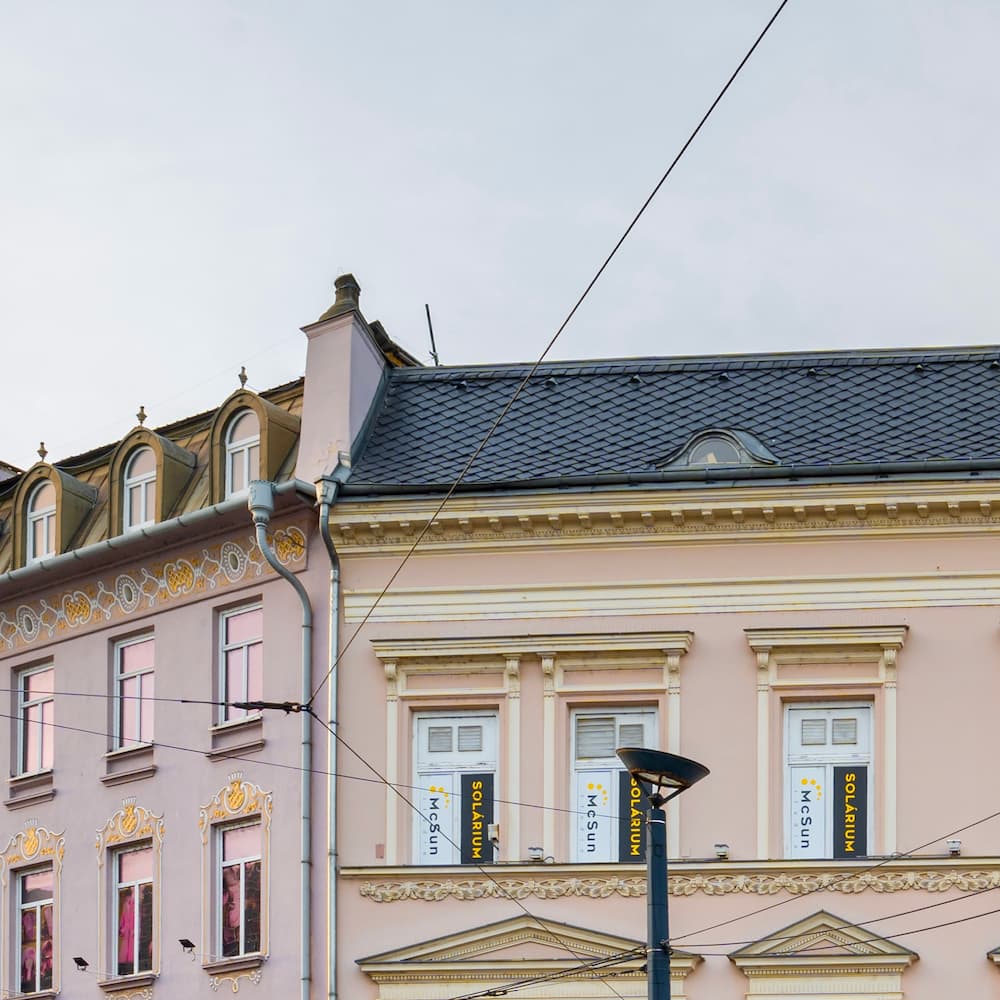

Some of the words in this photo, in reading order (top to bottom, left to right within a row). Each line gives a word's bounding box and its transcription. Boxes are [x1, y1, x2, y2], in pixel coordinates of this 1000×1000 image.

[429, 798, 440, 855] McSun
[472, 781, 485, 859] SOLÁRIUM
[586, 794, 598, 853] McSun
[801, 790, 812, 848] McSun
[845, 773, 858, 853] SOLÁRIUM
